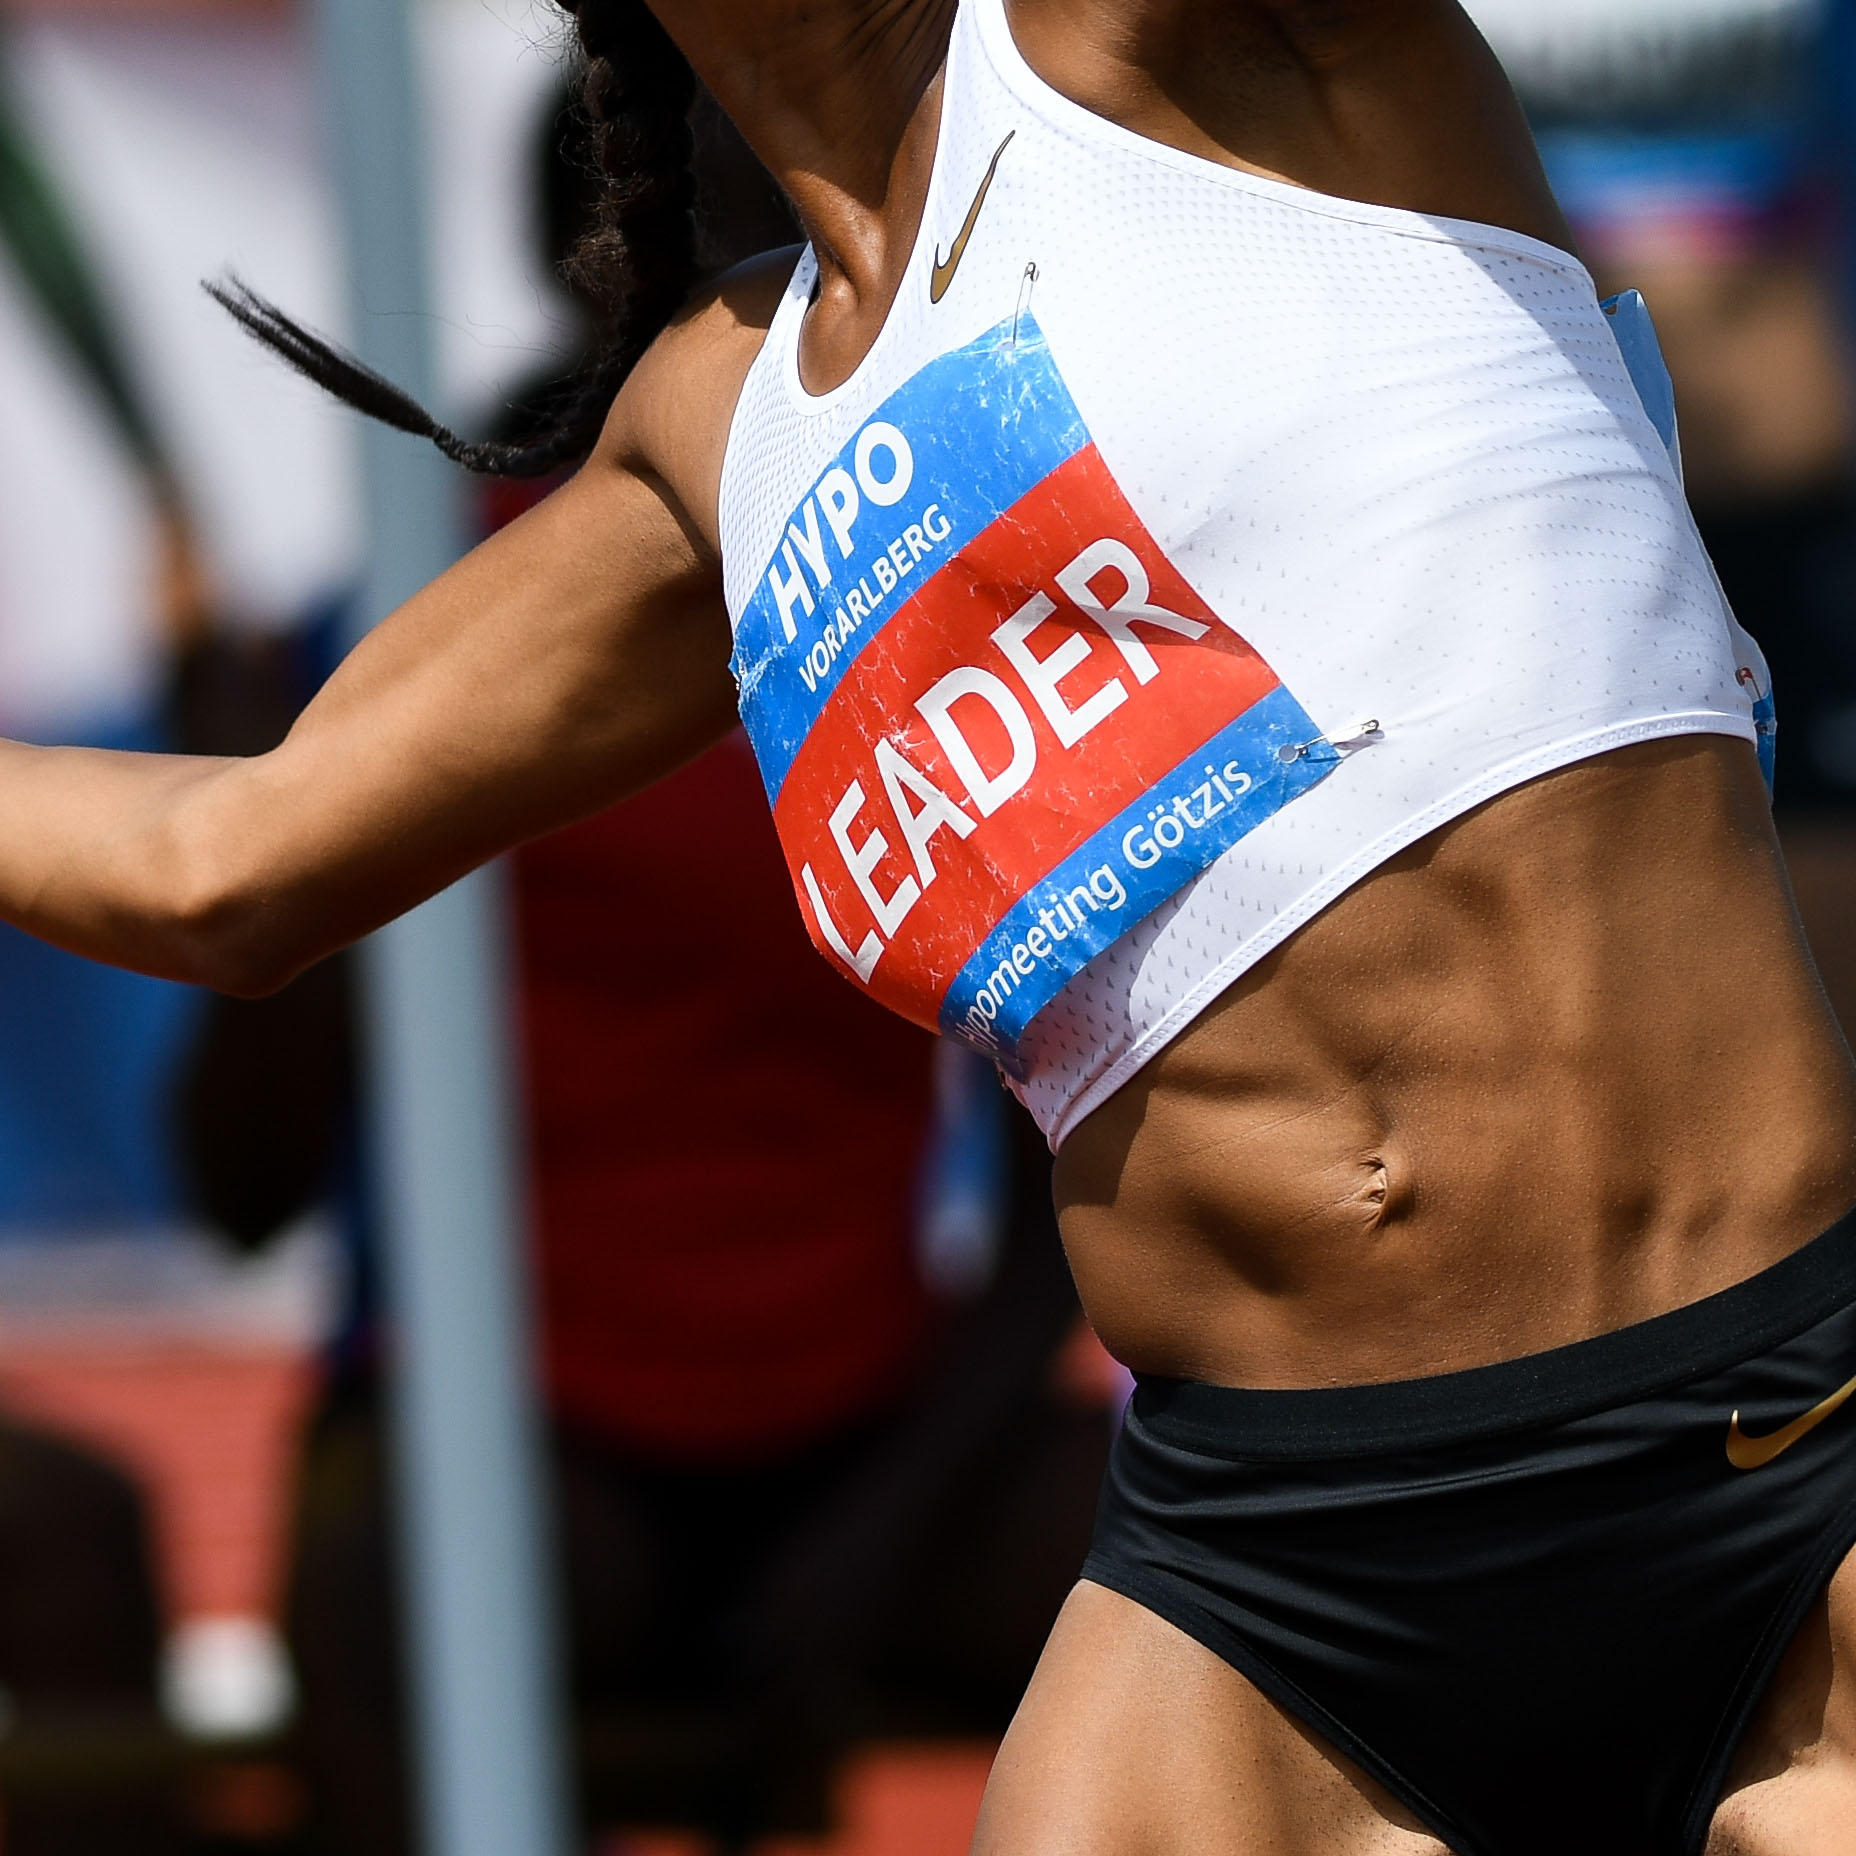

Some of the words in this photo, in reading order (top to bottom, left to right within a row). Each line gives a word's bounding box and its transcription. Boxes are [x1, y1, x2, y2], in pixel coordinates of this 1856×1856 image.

[767, 421, 914, 644] HYPO
[798, 503, 952, 693] VORARLBERG
[800, 537, 1211, 984] LEADER
[1122, 760, 1252, 869] Götzis
